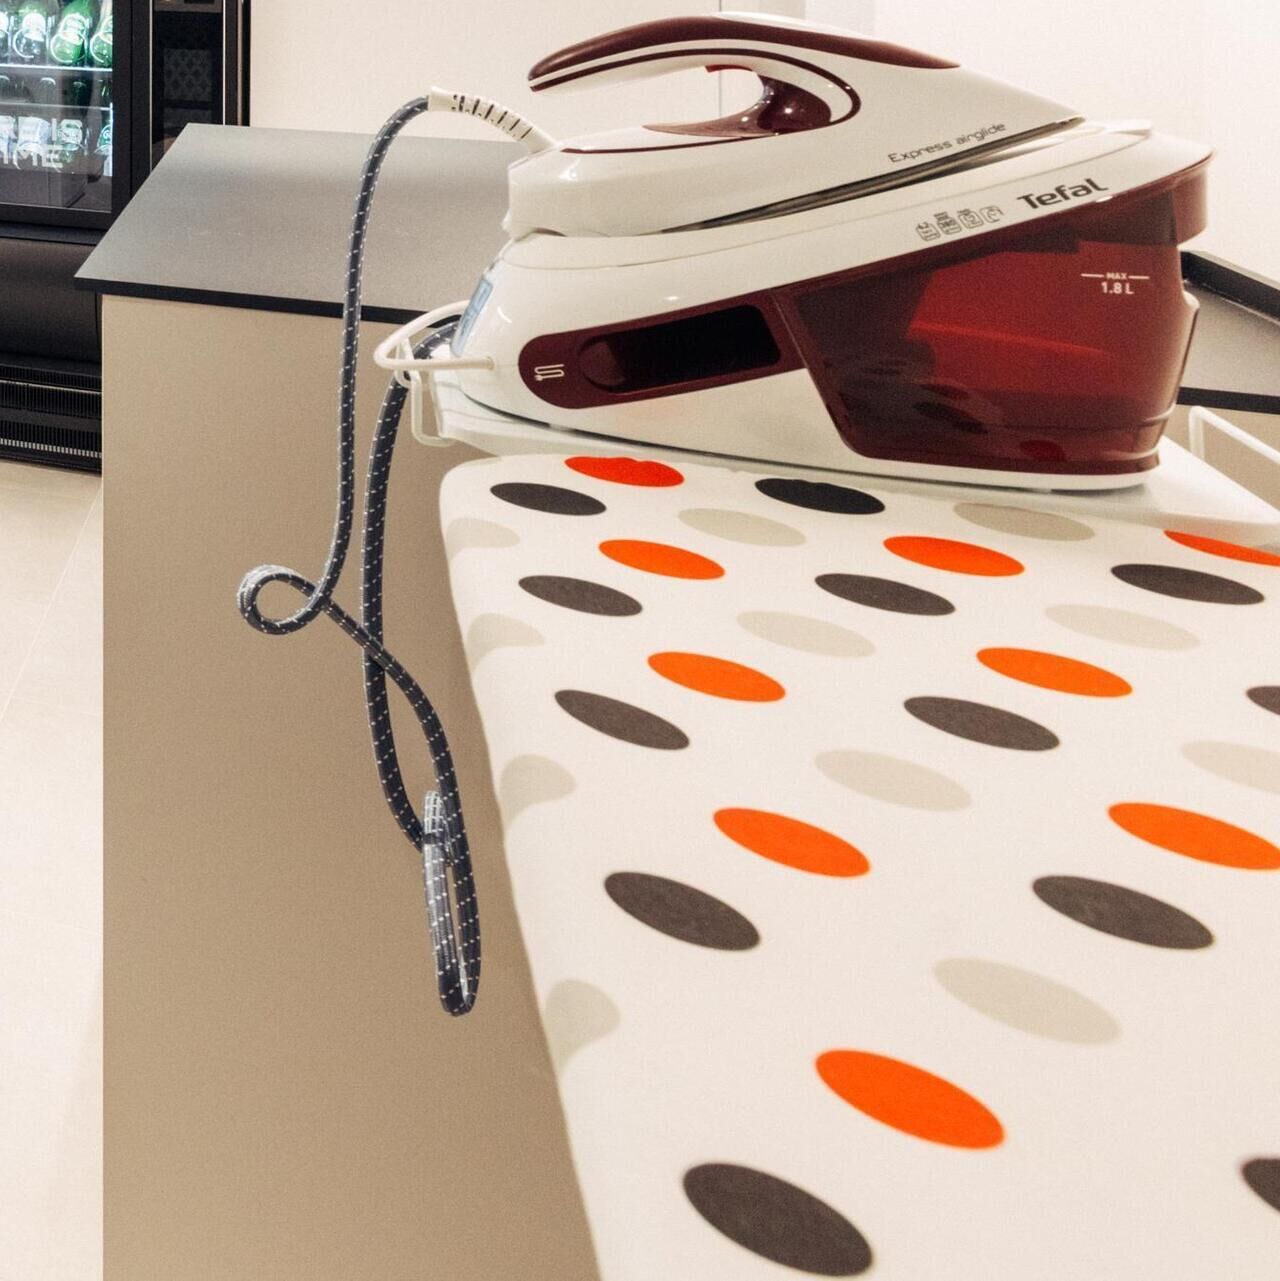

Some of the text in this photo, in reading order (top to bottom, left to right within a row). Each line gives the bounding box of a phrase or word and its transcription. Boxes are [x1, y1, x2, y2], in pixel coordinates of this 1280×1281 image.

[51, 117, 84, 143] IS
[888, 122, 1006, 163] Express airglide
[1017, 178, 1109, 209] Tefal
[1101, 282, 1134, 294] 1.8 L
[1106, 273, 1128, 281] MAX
